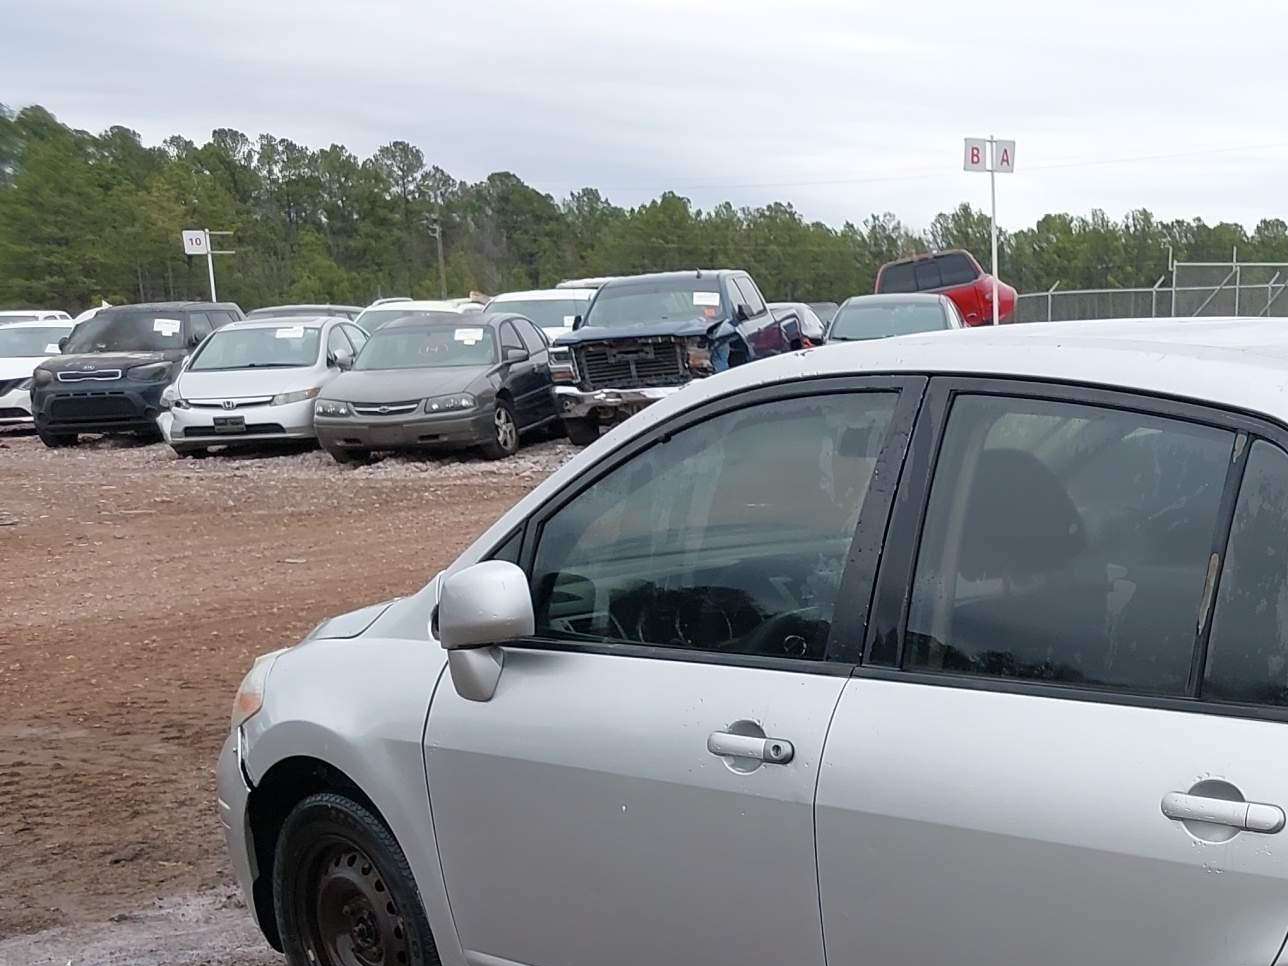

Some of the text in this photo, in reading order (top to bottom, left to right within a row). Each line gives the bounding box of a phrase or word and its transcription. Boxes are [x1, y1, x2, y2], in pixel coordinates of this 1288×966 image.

[970, 146, 981, 165] B
[1000, 148, 1010, 167] A
[189, 237, 202, 247] 10
